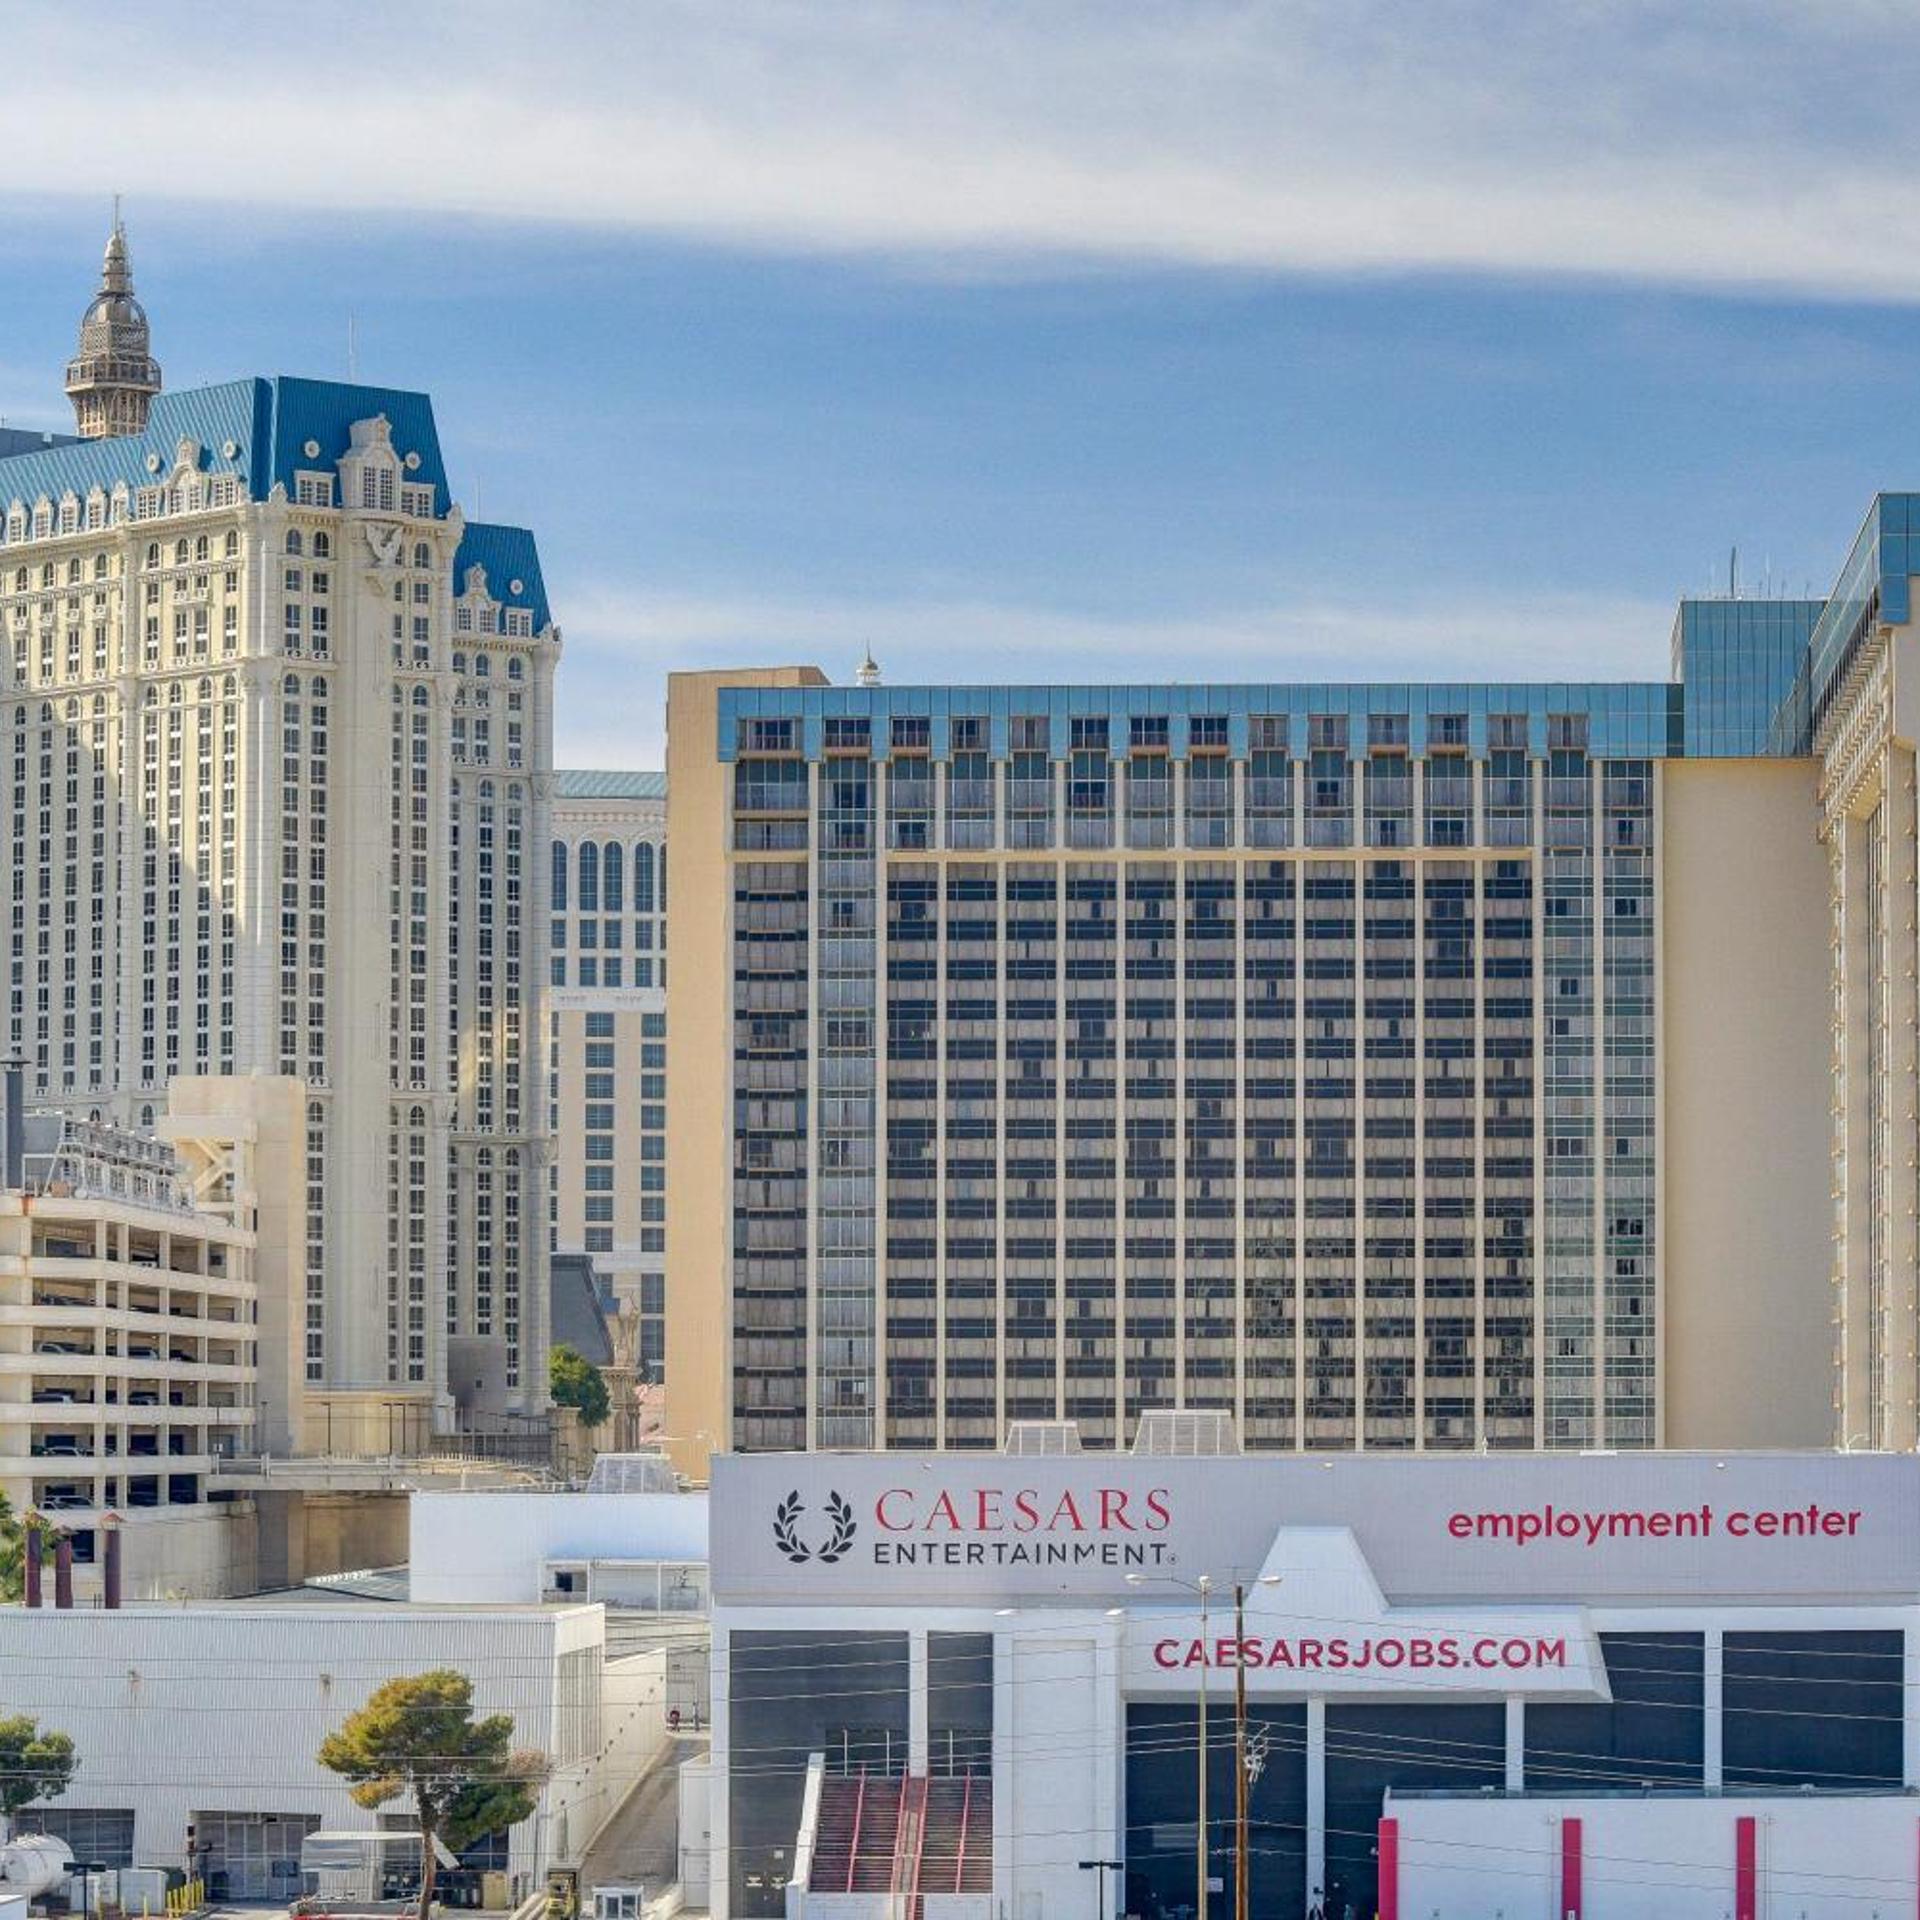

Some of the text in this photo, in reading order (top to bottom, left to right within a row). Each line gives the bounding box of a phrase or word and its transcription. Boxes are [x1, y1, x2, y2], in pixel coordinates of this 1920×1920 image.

[876, 1487, 1172, 1531] CAESARS
[1447, 1503, 1862, 1546] employment center
[874, 1543, 1167, 1565] ENTERTAINMENT
[1154, 1637, 1566, 1669] CAESARSJOBS.COM
